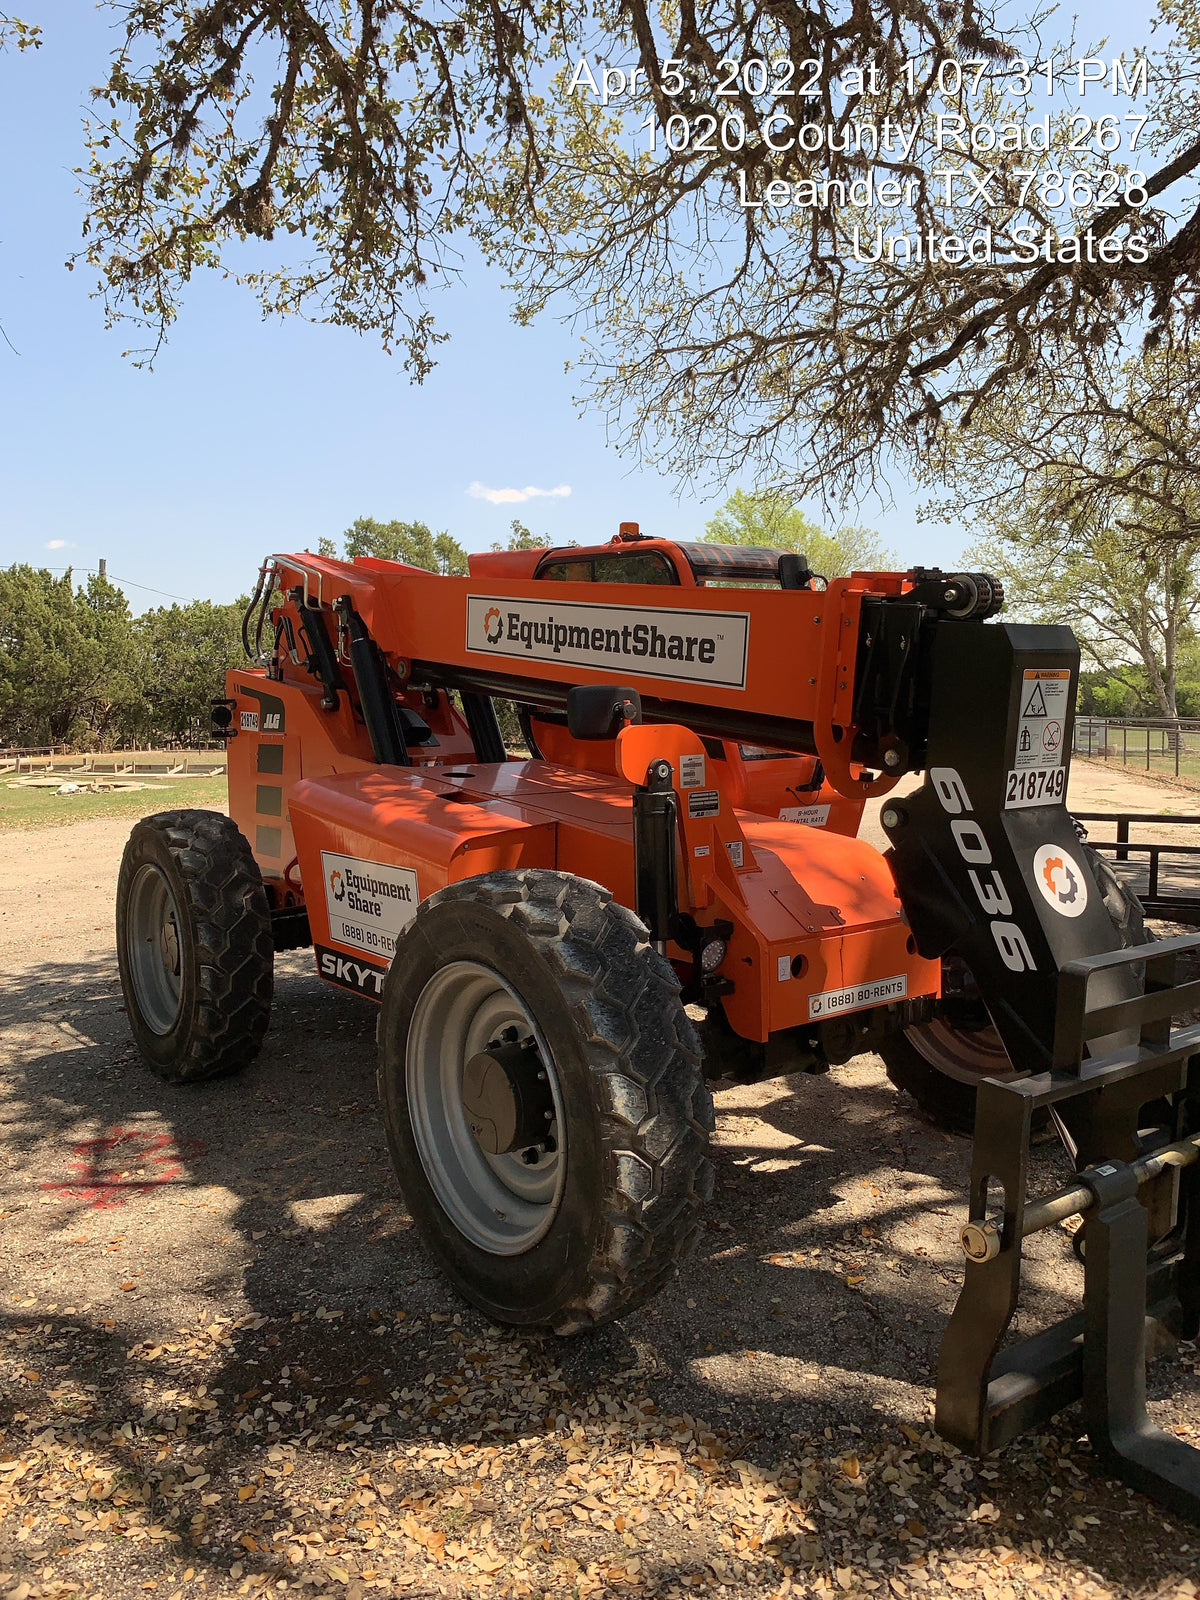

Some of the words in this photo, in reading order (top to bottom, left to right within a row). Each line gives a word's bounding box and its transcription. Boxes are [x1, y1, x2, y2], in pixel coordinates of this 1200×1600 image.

[506, 612, 716, 665] EquipmentShare
[263, 713, 281, 729] JLG
[1006, 769, 1064, 802] 218749
[345, 868, 412, 903] Equipment
[929, 767, 1038, 973] 6036
[347, 891, 382, 917] Share
[342, 922, 365, 943] (888)
[366, 930, 397, 952] 80-REN
[321, 953, 385, 994] SKYT
[827, 992, 855, 1009] (888)
[857, 982, 903, 1001] 80-RENTS
